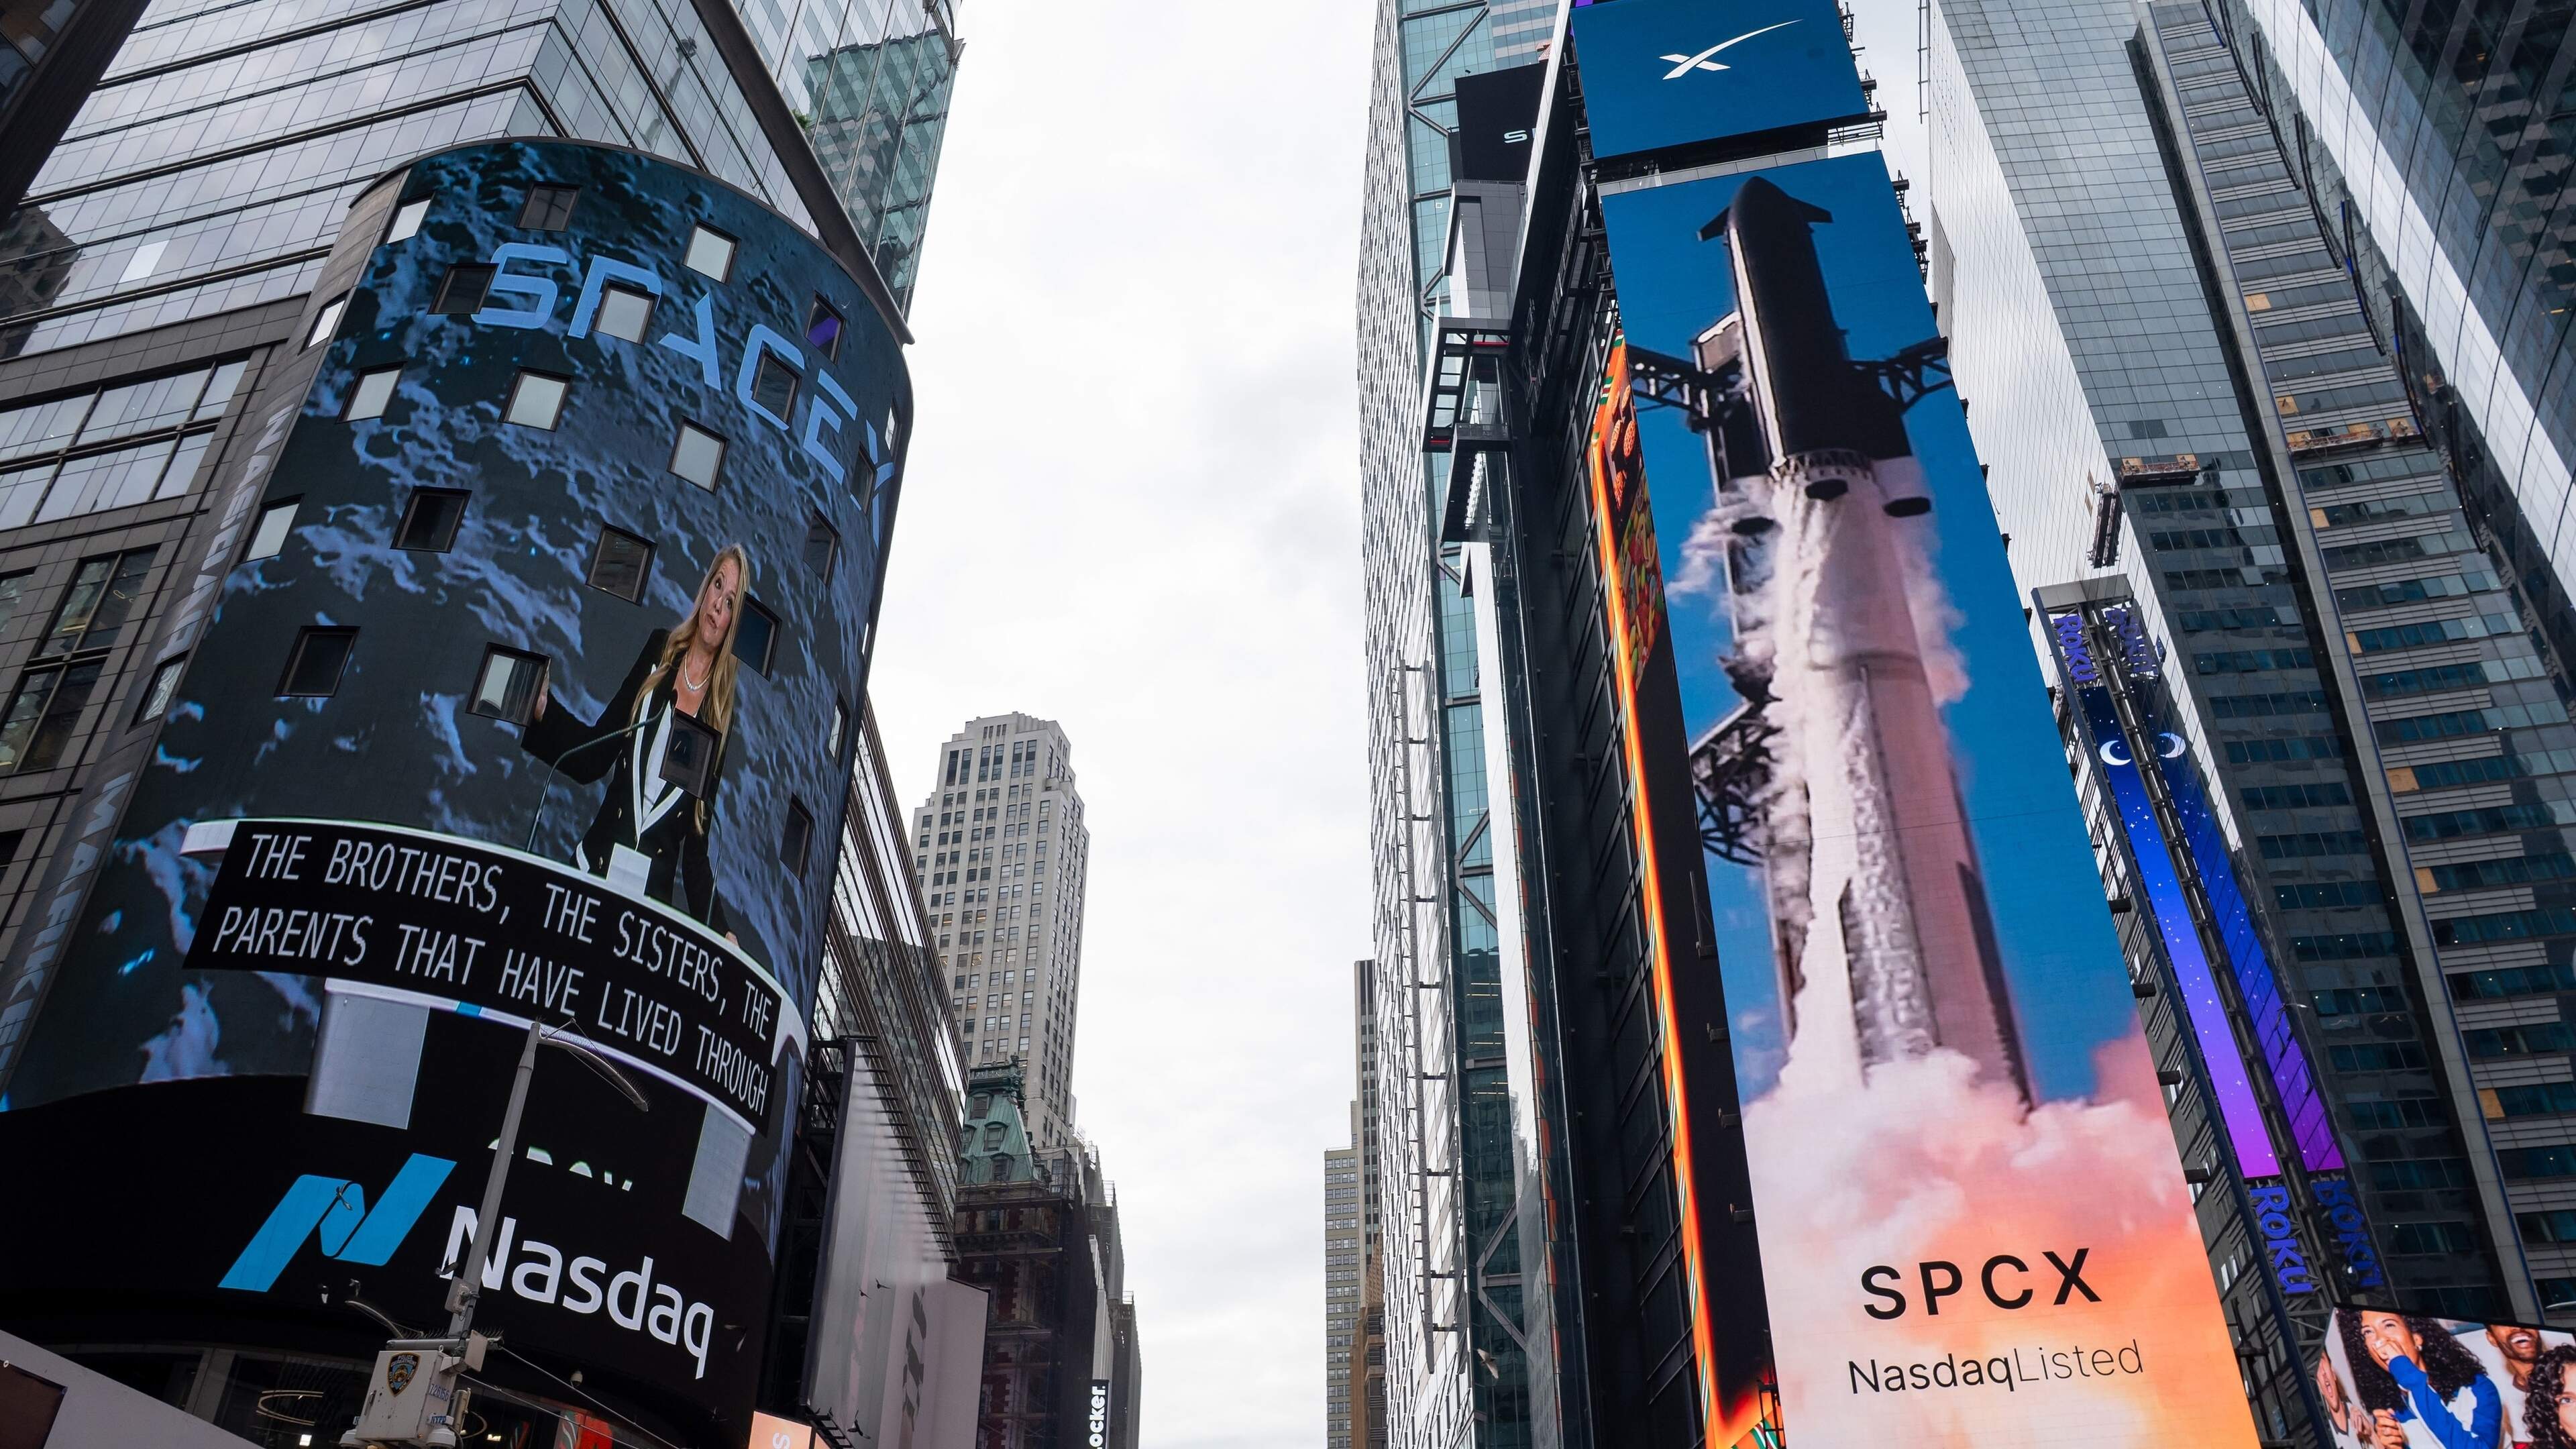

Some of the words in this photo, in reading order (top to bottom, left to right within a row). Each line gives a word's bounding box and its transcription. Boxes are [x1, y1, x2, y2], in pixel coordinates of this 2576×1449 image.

[154, 402, 295, 666] NASDAQ
[2053, 615, 2097, 683] ROKU
[246, 834, 313, 880] THE
[324, 839, 510, 924] BROTHERS,
[543, 883, 601, 944] THE
[613, 911, 726, 1016] SISTERS,
[743, 980, 772, 1041] THE
[213, 907, 374, 965] PARENTS
[395, 924, 486, 985] THAT
[498, 949, 584, 1016] HAVE
[598, 982, 682, 1056] LIVED
[696, 1024, 769, 1116] THROUGH
[439, 1205, 714, 1379] Nasdaq
[1861, 1247, 2102, 1320] SPCX
[2249, 1186, 2314, 1294] ROKU
[431, 1415, 447, 1424] NYPD
[1089, 1386, 1106, 1449] ocker.
